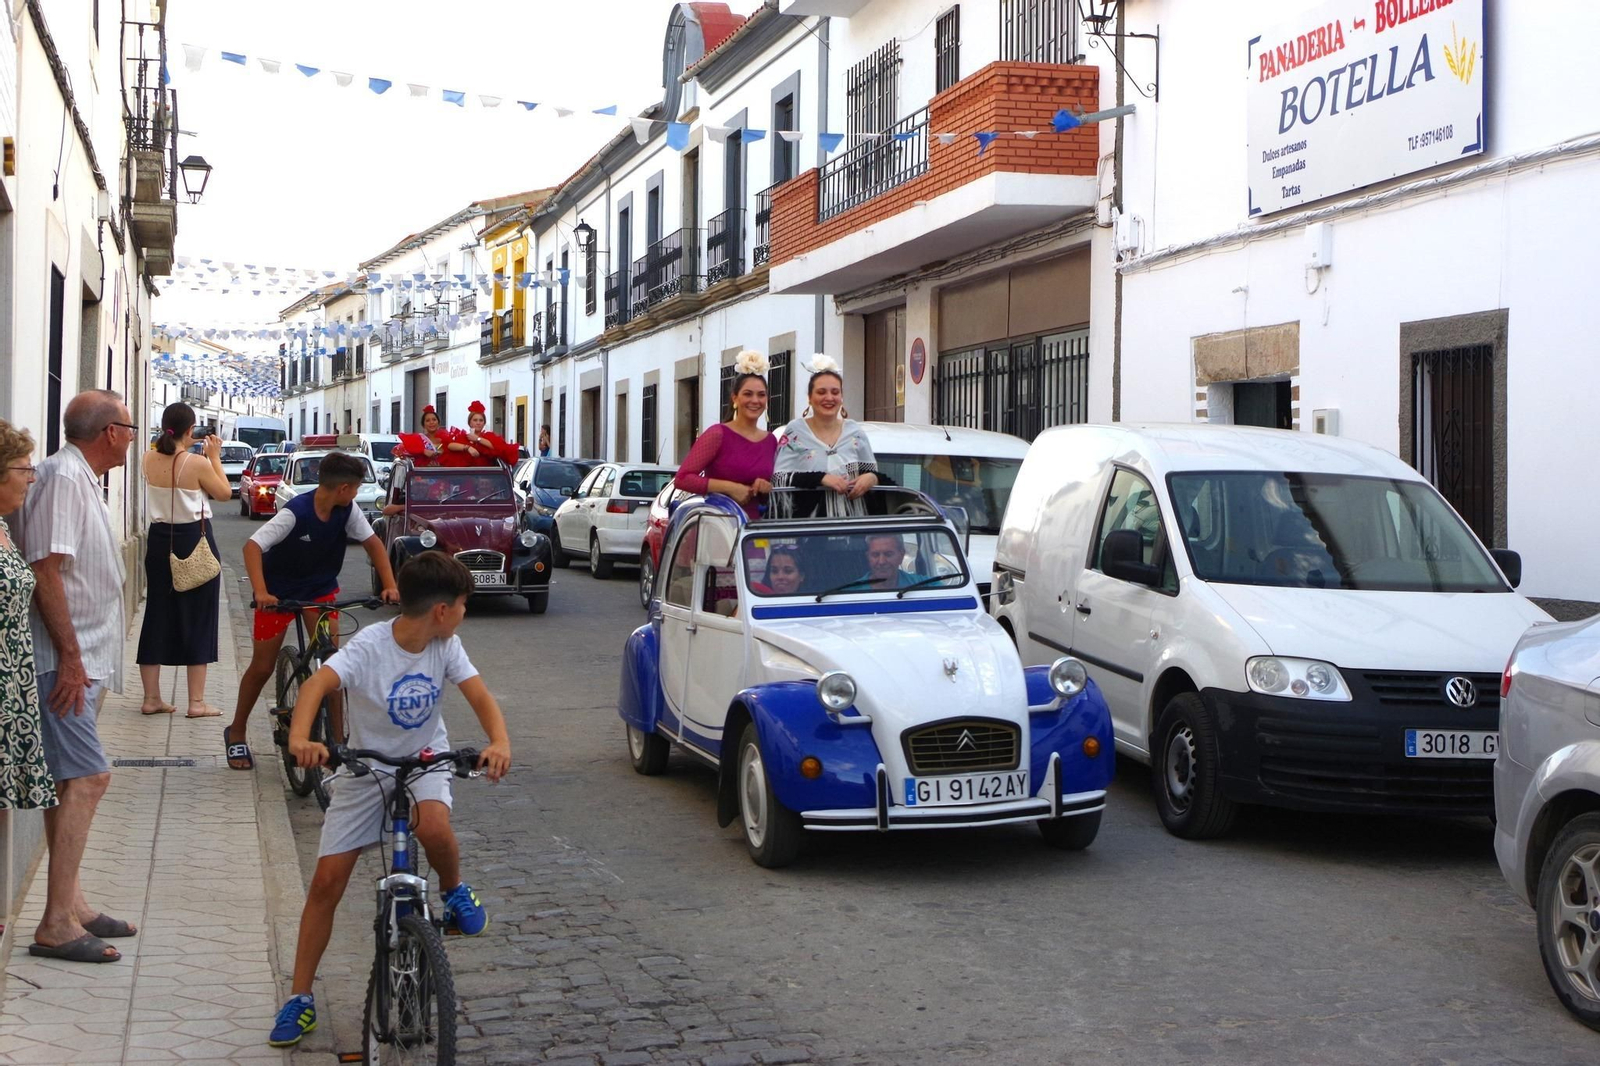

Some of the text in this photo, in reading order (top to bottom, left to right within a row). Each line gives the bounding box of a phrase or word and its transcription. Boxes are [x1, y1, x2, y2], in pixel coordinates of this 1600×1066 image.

[1259, 19, 1345, 83] PANADERIA
[1278, 33, 1435, 135] BOTELLA
[1262, 140, 1307, 163] Dulces artesanos
[1408, 135, 1419, 151] TLF
[1272, 158, 1306, 179] Empanadas
[1281, 185, 1301, 199] Tartas
[473, 574, 505, 584] 6085 N
[228, 744, 248, 757] GET
[1422, 733, 1471, 754] 3018
[917, 780, 941, 802] GI
